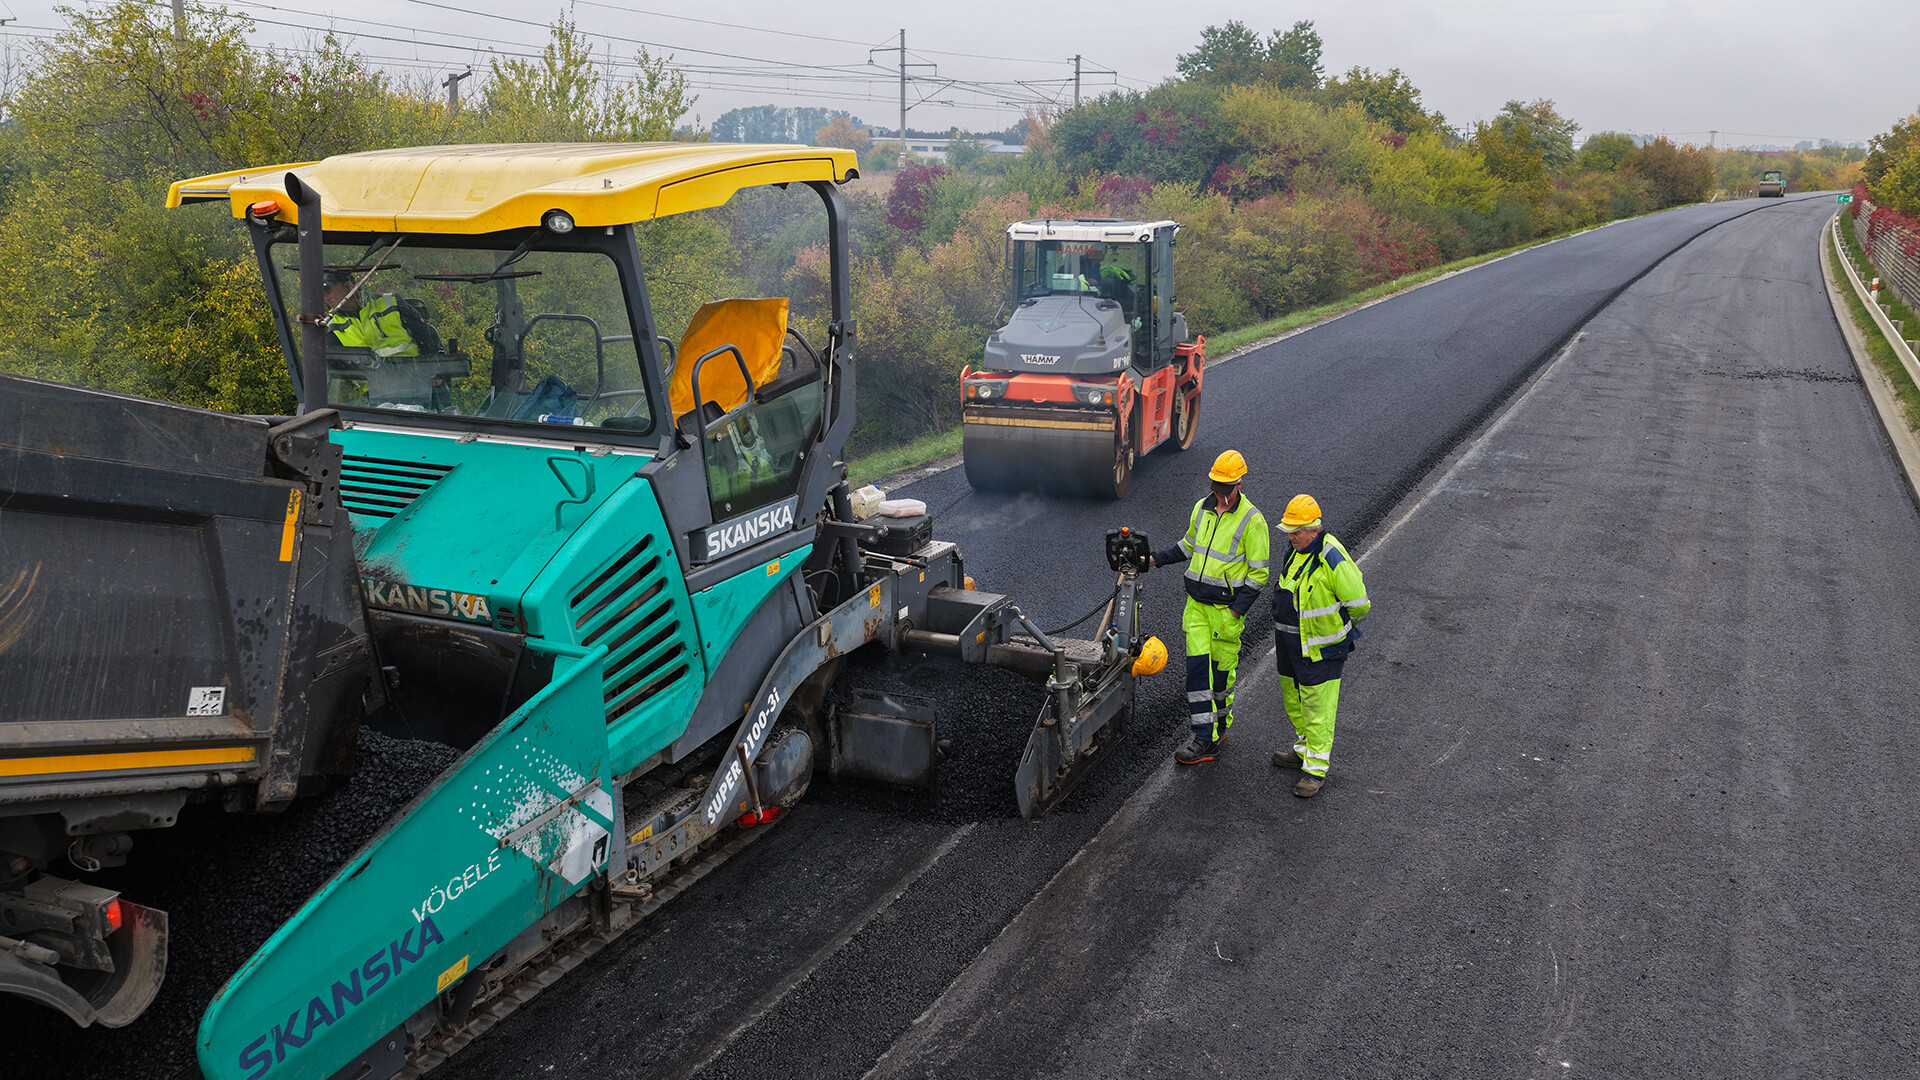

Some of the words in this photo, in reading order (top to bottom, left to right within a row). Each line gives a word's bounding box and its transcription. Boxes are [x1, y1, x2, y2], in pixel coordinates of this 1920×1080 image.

[1056, 244, 1095, 255] HAMM
[1026, 355, 1054, 364] HAMM
[707, 505, 794, 557] SKANSKA
[361, 579, 492, 622] KANSKA
[707, 760, 742, 825] SUPER
[411, 847, 501, 923] VÖGELE
[238, 915, 445, 1080] SKANSKA
